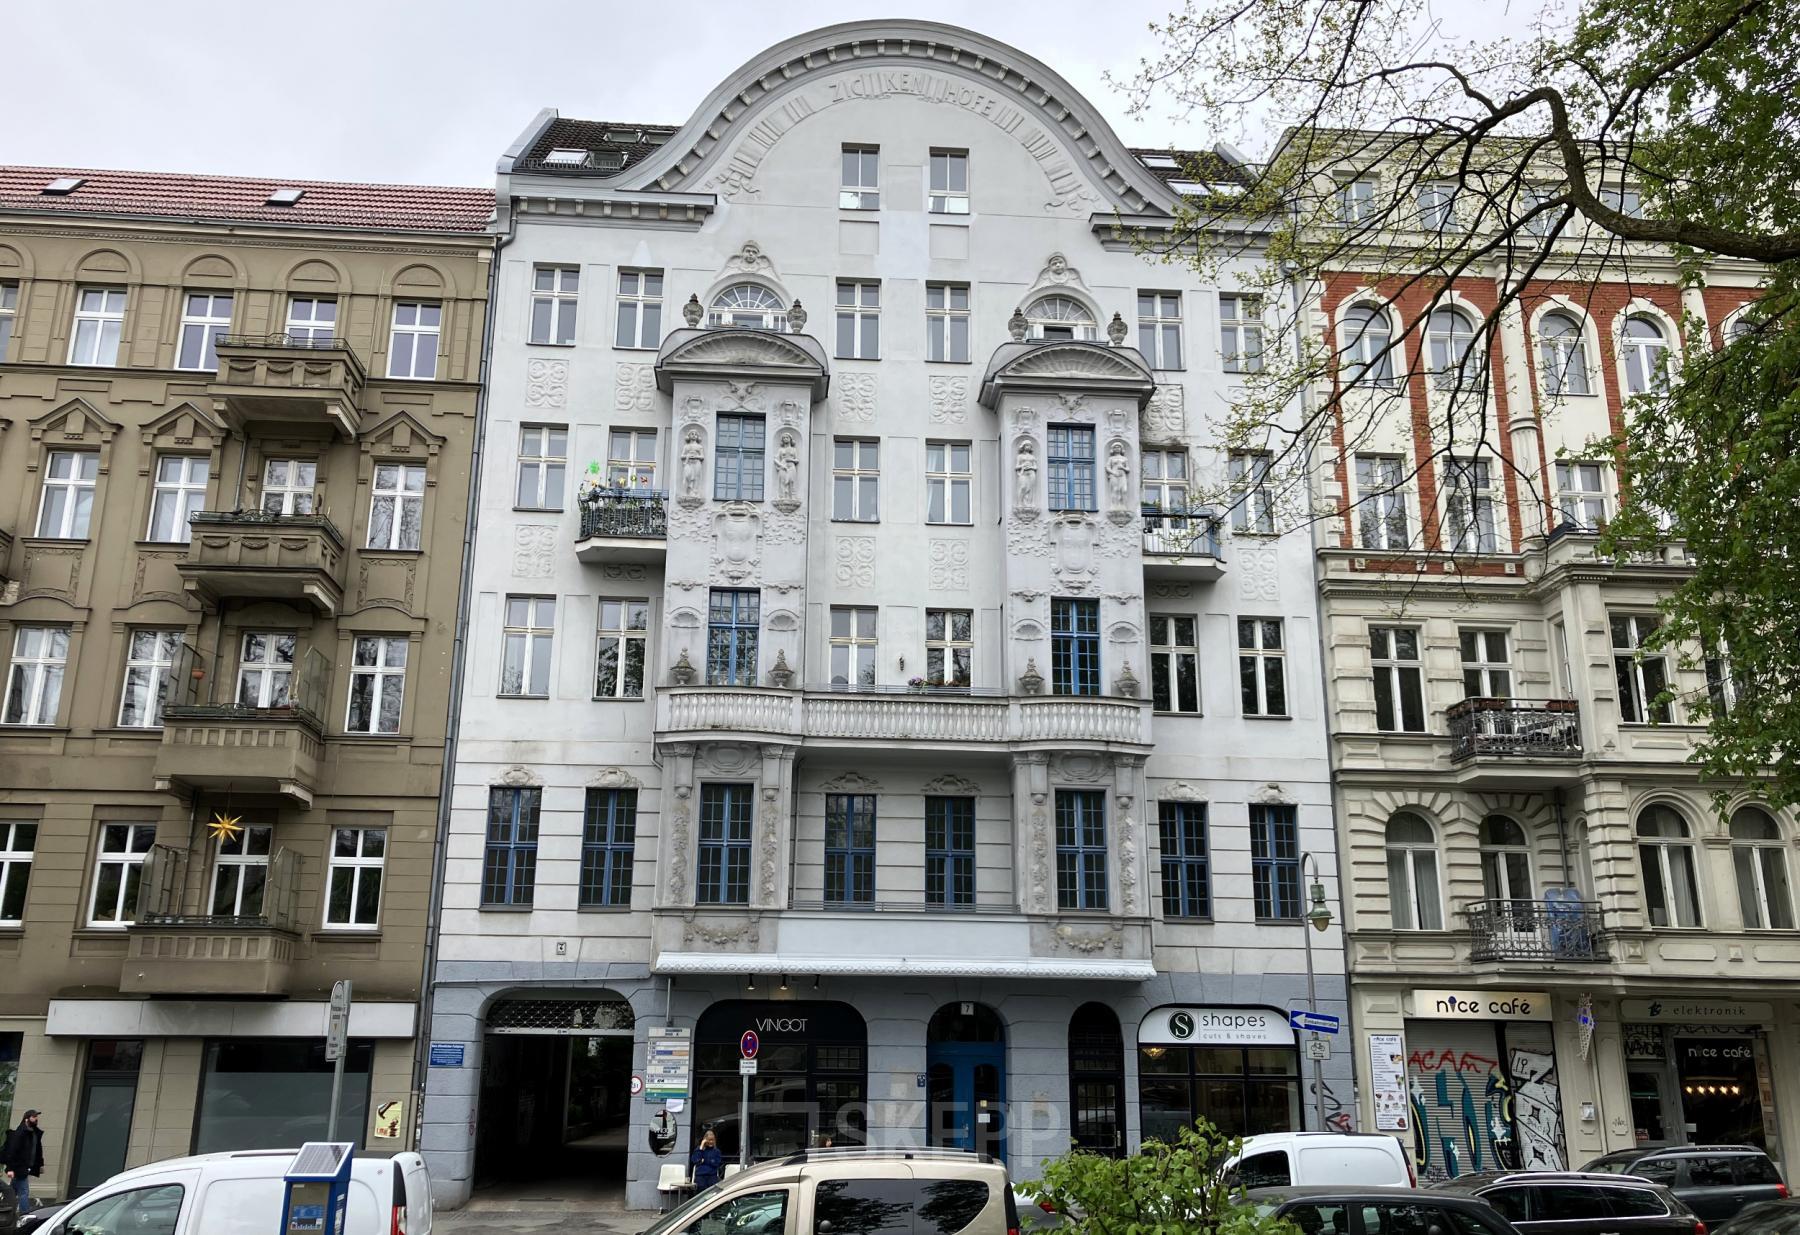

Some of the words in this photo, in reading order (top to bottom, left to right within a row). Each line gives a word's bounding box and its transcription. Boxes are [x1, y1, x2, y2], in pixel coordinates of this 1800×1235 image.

[1436, 995, 1479, 1014] nice
[1488, 997, 1531, 1015] café
[1673, 1004, 1746, 1016] elektronik
[1202, 1012, 1266, 1029] shapes
[1203, 1032, 1222, 1040] cuts
[1236, 1032, 1268, 1040] shaves
[1723, 1045, 1751, 1058] café
